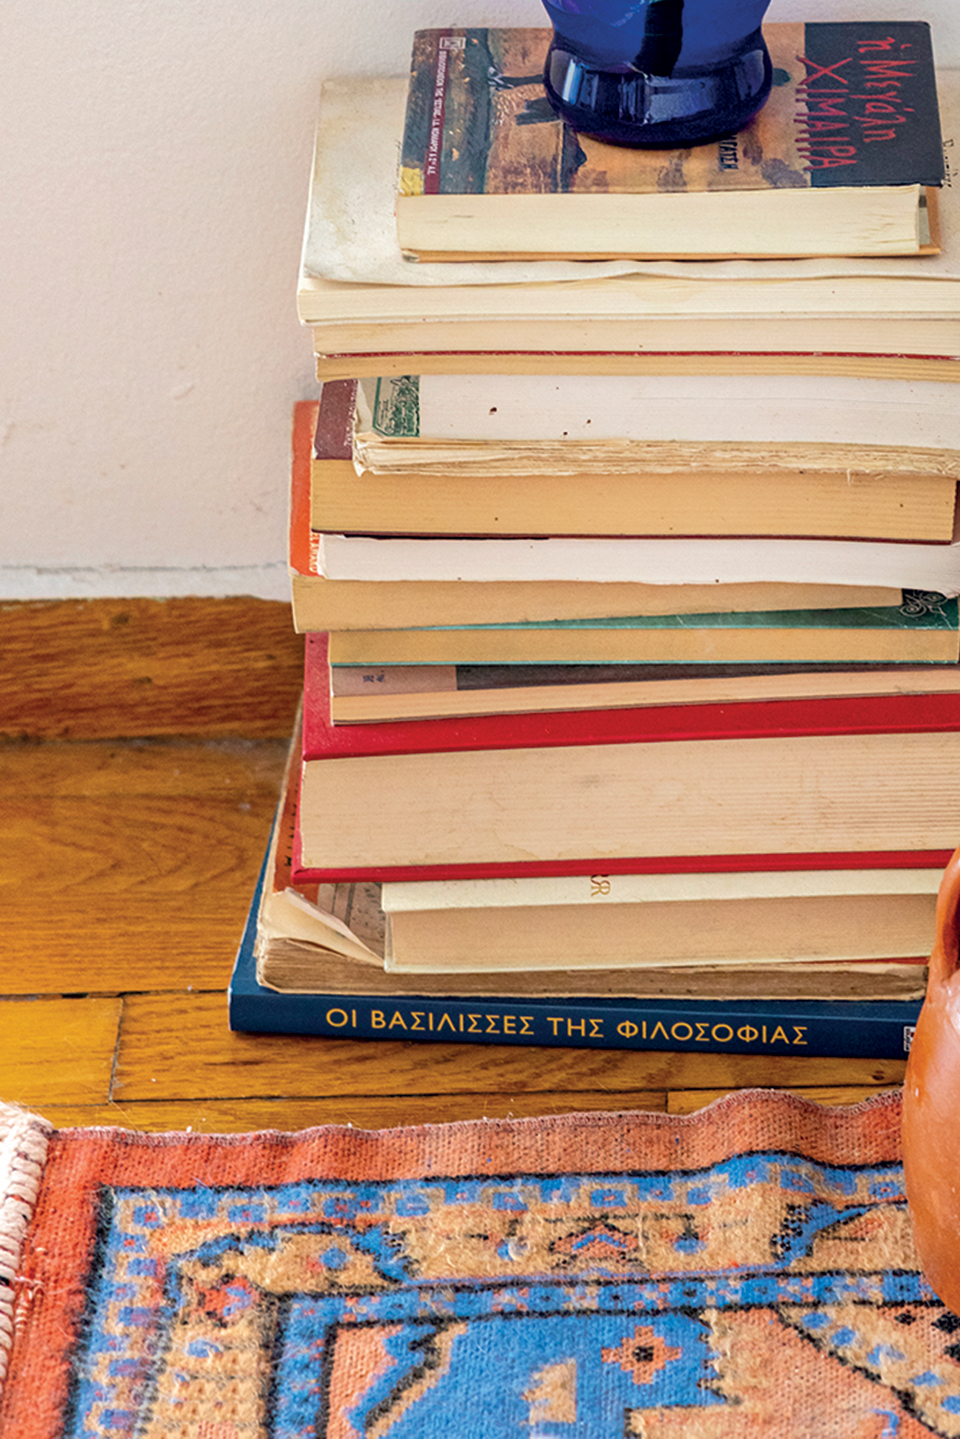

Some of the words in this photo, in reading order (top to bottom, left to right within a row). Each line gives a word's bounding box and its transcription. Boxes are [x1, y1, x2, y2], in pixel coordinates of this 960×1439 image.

[793, 56, 858, 171] ΧΙΜΑΙΡΑ
[326, 1008, 357, 1028] ΟΙ
[371, 1010, 535, 1036] ΒΑΣΙΛΙΣΣΕΣ
[546, 1017, 604, 1038] ΤΗΣ
[616, 1020, 808, 1045] ΦΙΛΟΣΟΦΙΑΣ
